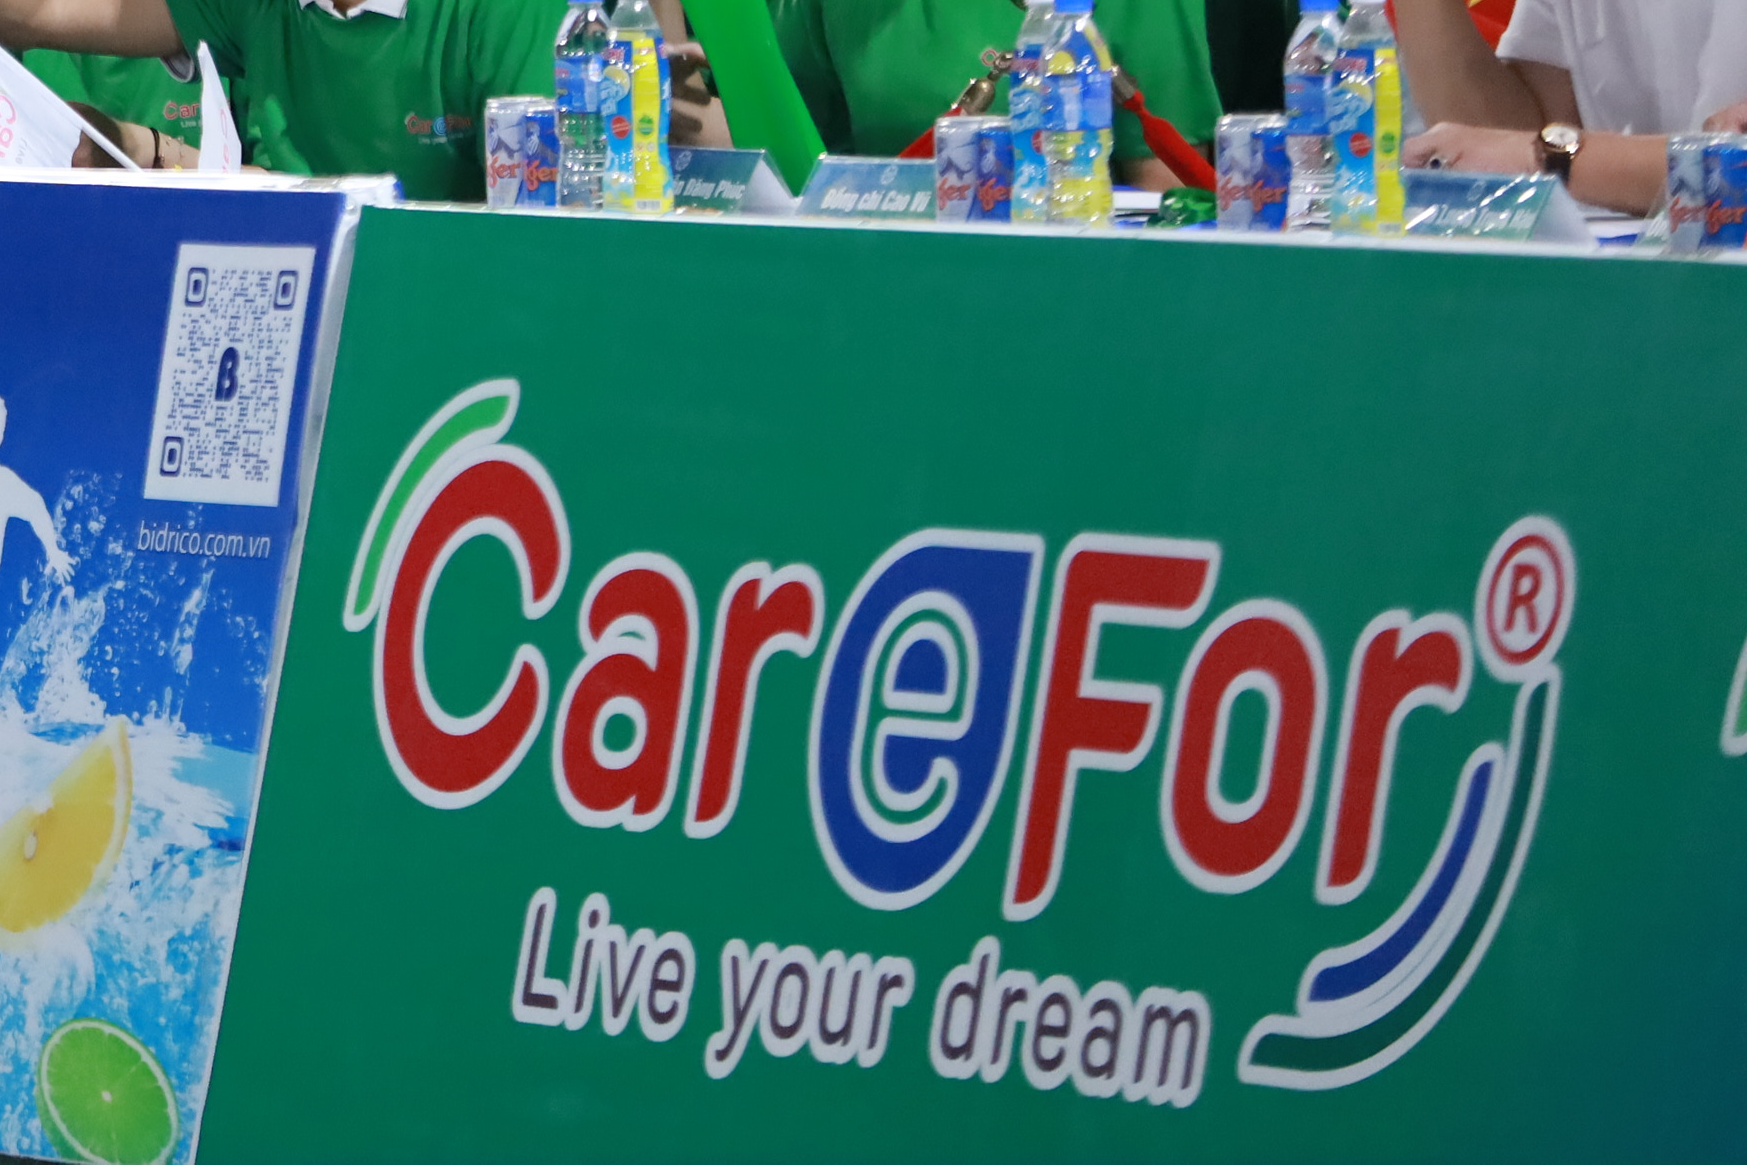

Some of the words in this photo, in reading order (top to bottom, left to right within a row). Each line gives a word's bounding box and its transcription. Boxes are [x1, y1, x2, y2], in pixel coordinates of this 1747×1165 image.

[136, 519, 271, 559] bidrico.com.vn
[371, 443, 1475, 921] CareFor
[510, 885, 696, 1042] Live
[705, 939, 916, 1080] your
[928, 935, 1215, 1109] dream
